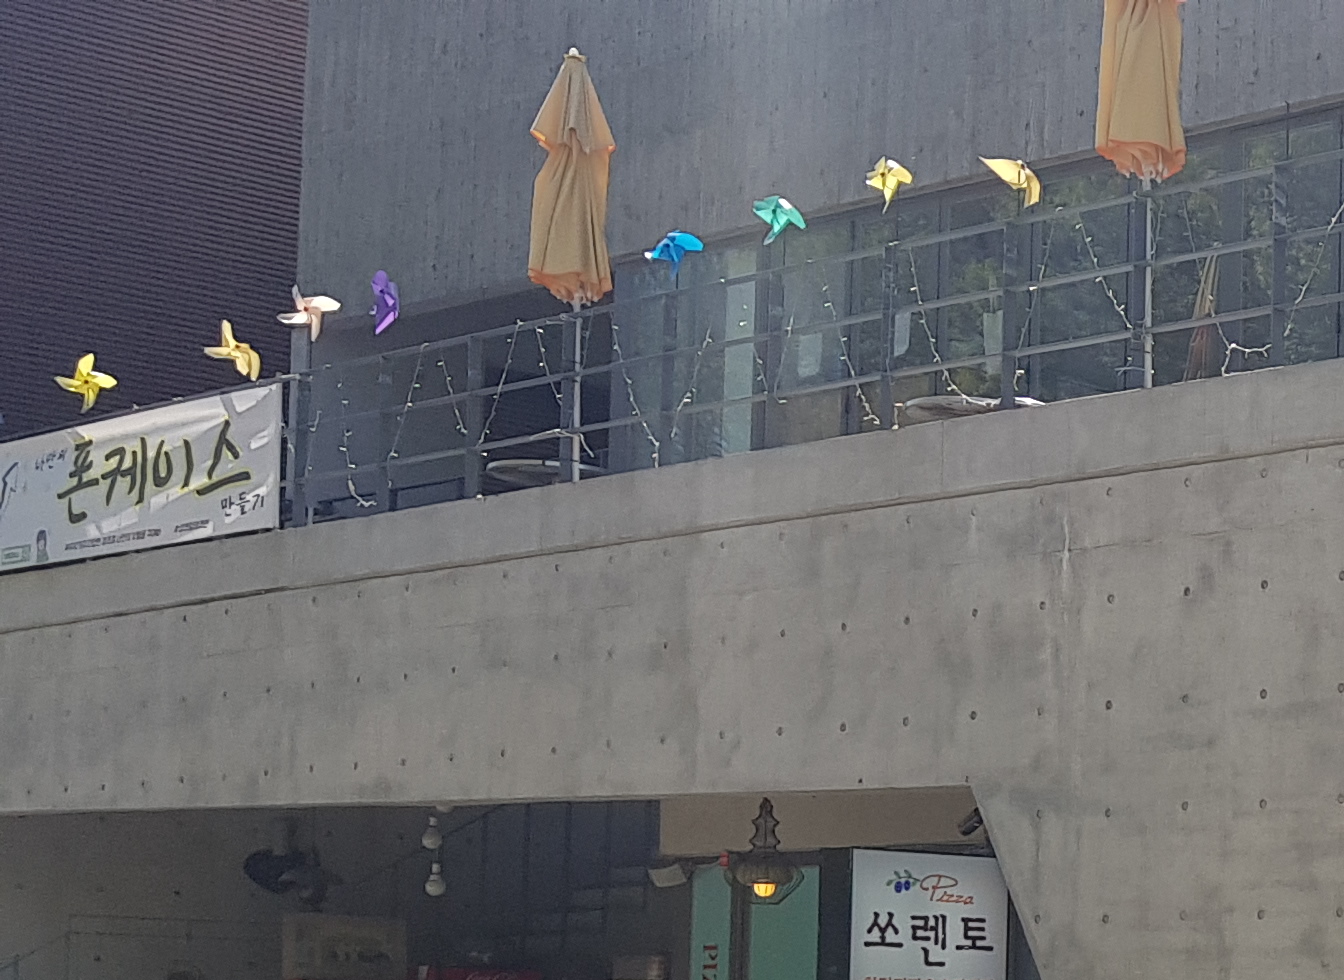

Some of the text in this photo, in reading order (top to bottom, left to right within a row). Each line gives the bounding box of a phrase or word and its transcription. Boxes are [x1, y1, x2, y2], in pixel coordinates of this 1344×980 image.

[57, 417, 252, 524] 폰케이스
[220, 491, 265, 517] 만들기
[920, 874, 975, 905] Pizza
[863, 911, 994, 967] 쏘렌토
